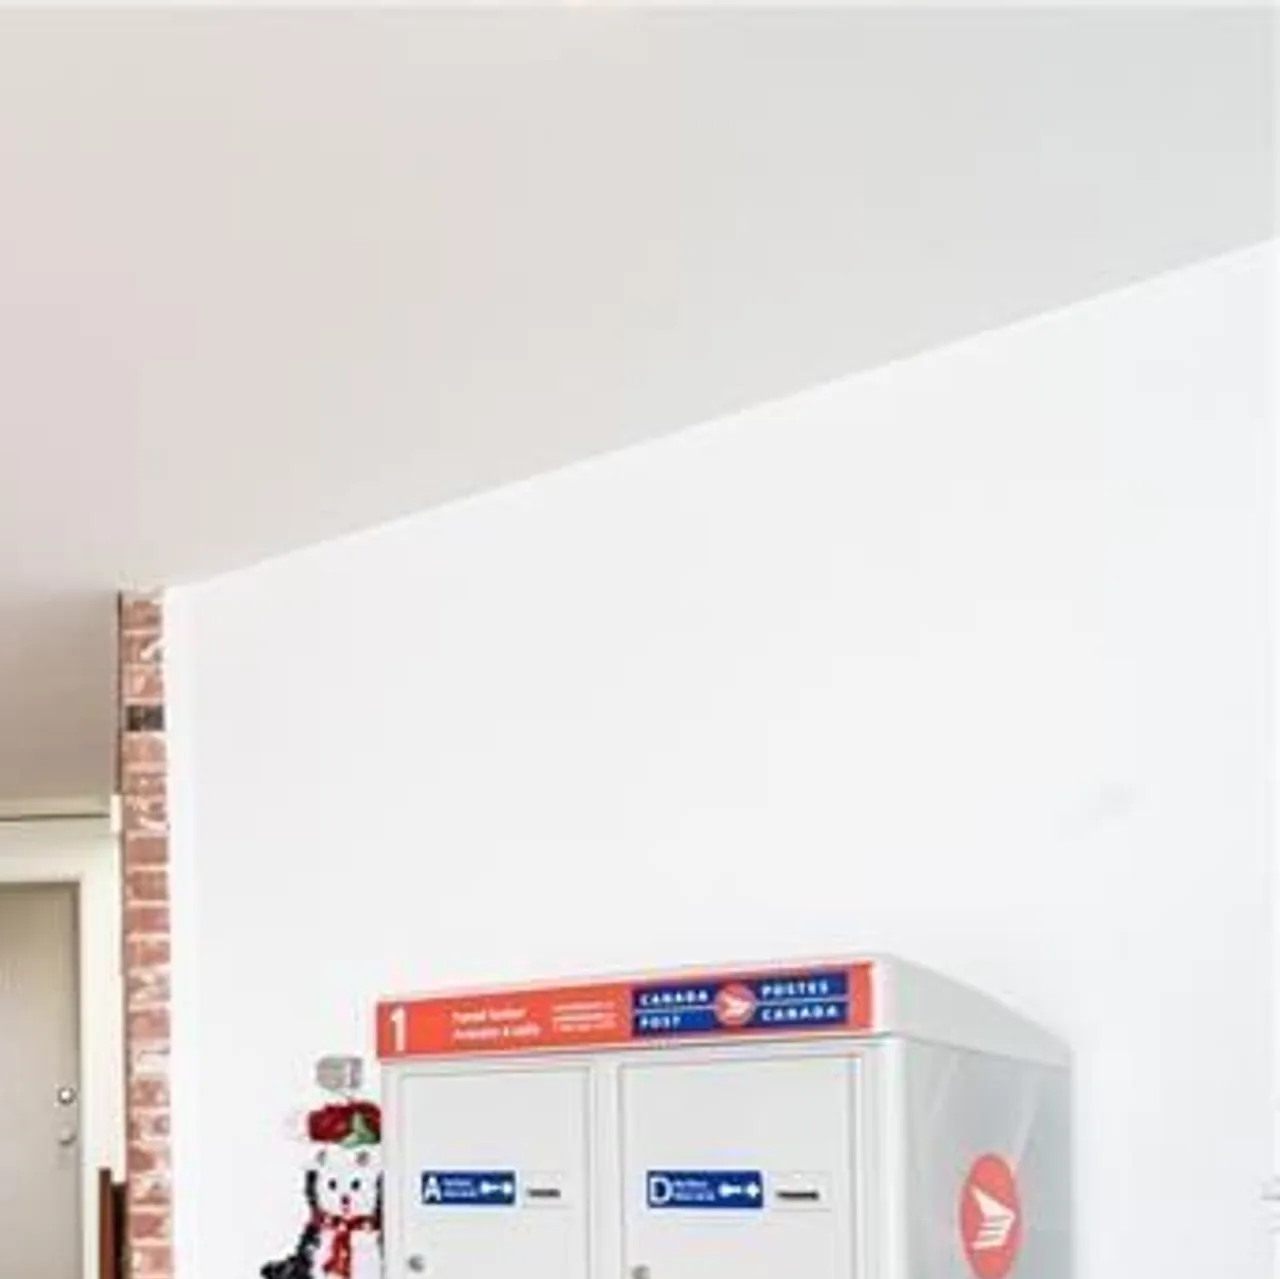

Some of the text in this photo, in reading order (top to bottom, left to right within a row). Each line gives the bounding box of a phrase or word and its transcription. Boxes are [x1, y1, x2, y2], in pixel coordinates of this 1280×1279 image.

[761, 1003, 840, 1022] CANADA
[391, 1006, 407, 1052] 1
[425, 1175, 441, 1202] A
[649, 1176, 674, 1205] D
